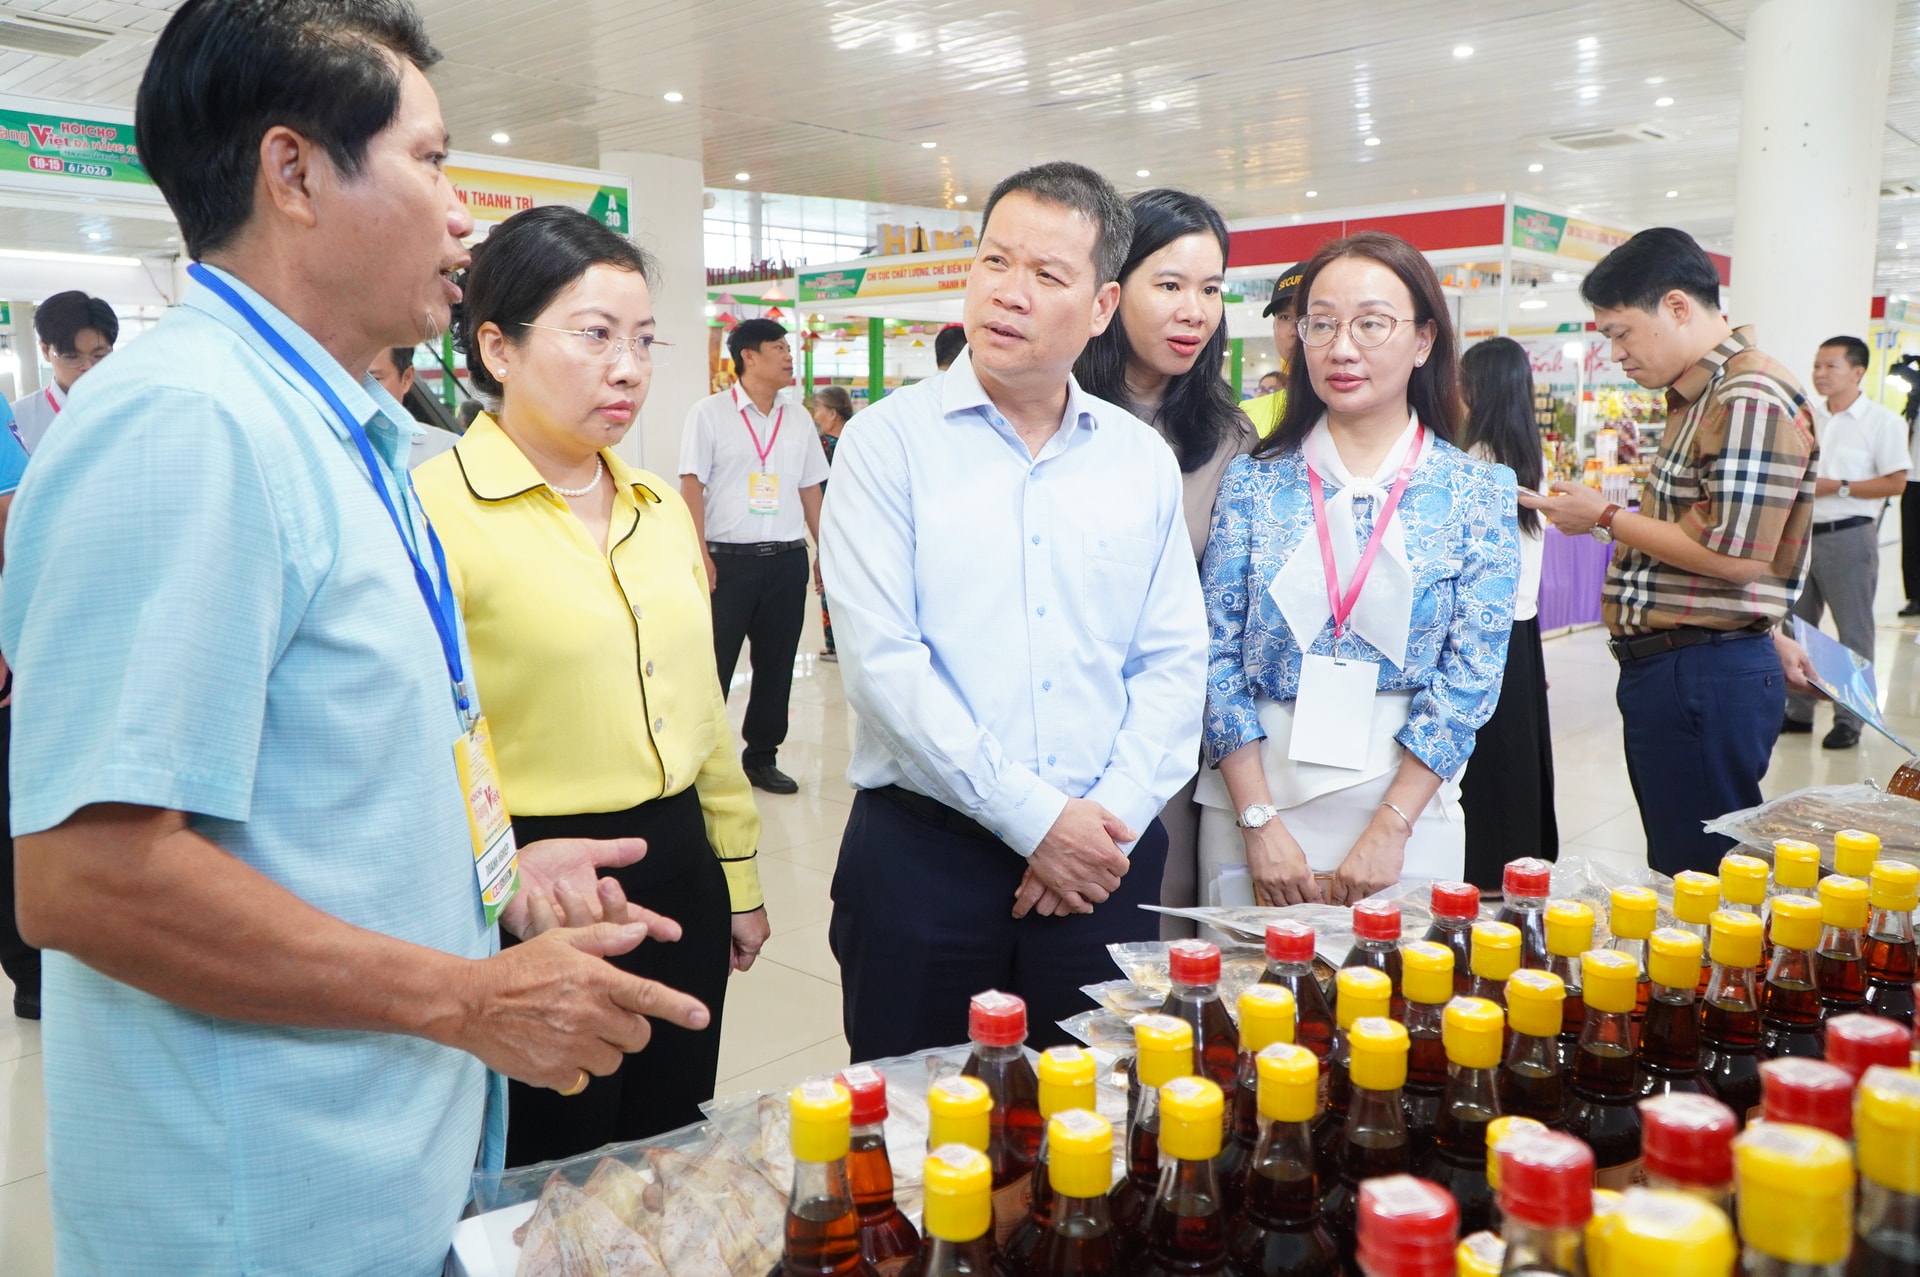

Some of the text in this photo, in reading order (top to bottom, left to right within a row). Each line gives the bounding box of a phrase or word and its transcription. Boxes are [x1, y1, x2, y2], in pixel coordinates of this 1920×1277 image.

[28, 124, 69, 149] Việt
[33, 157, 108, 177] 10-15 6/2026
[471, 191, 511, 210] THANH
[515, 194, 534, 210] TRÌ
[607, 194, 617, 211] A
[604, 211, 621, 228] 30
